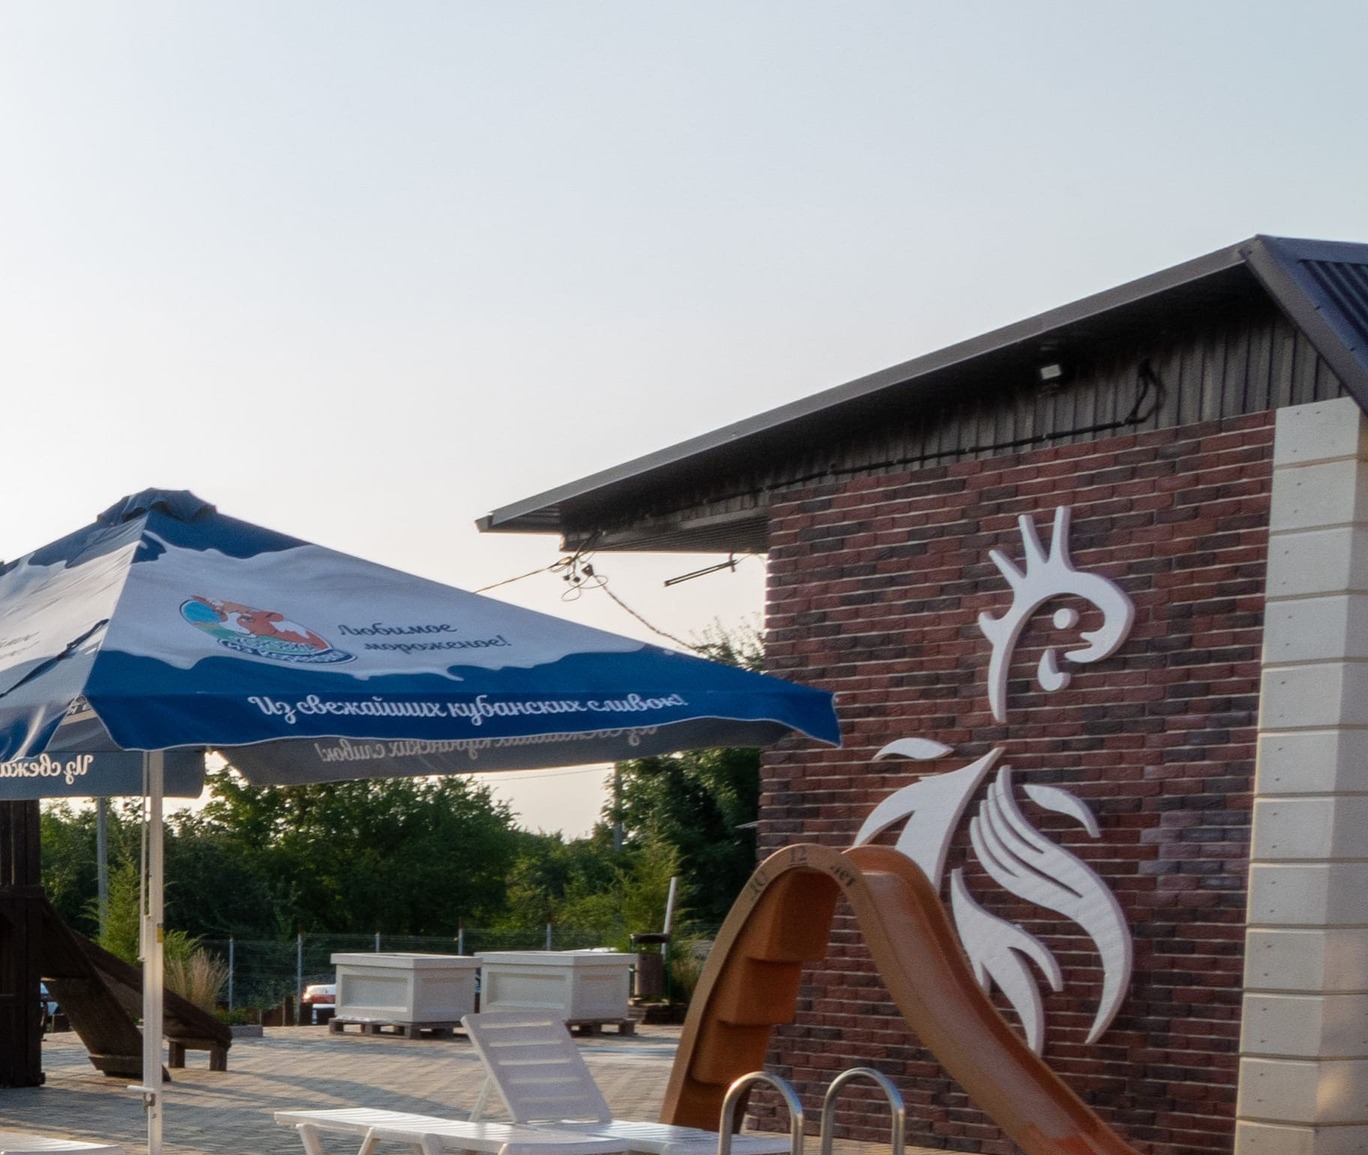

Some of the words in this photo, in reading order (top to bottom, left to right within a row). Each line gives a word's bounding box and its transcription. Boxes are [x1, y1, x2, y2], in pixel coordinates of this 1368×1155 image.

[338, 622, 457, 636] Любимое
[364, 635, 512, 654] мороженое!
[248, 695, 297, 724] Из
[297, 694, 447, 718] свежайших
[448, 695, 587, 726] кубанских
[588, 692, 688, 712] сливок!
